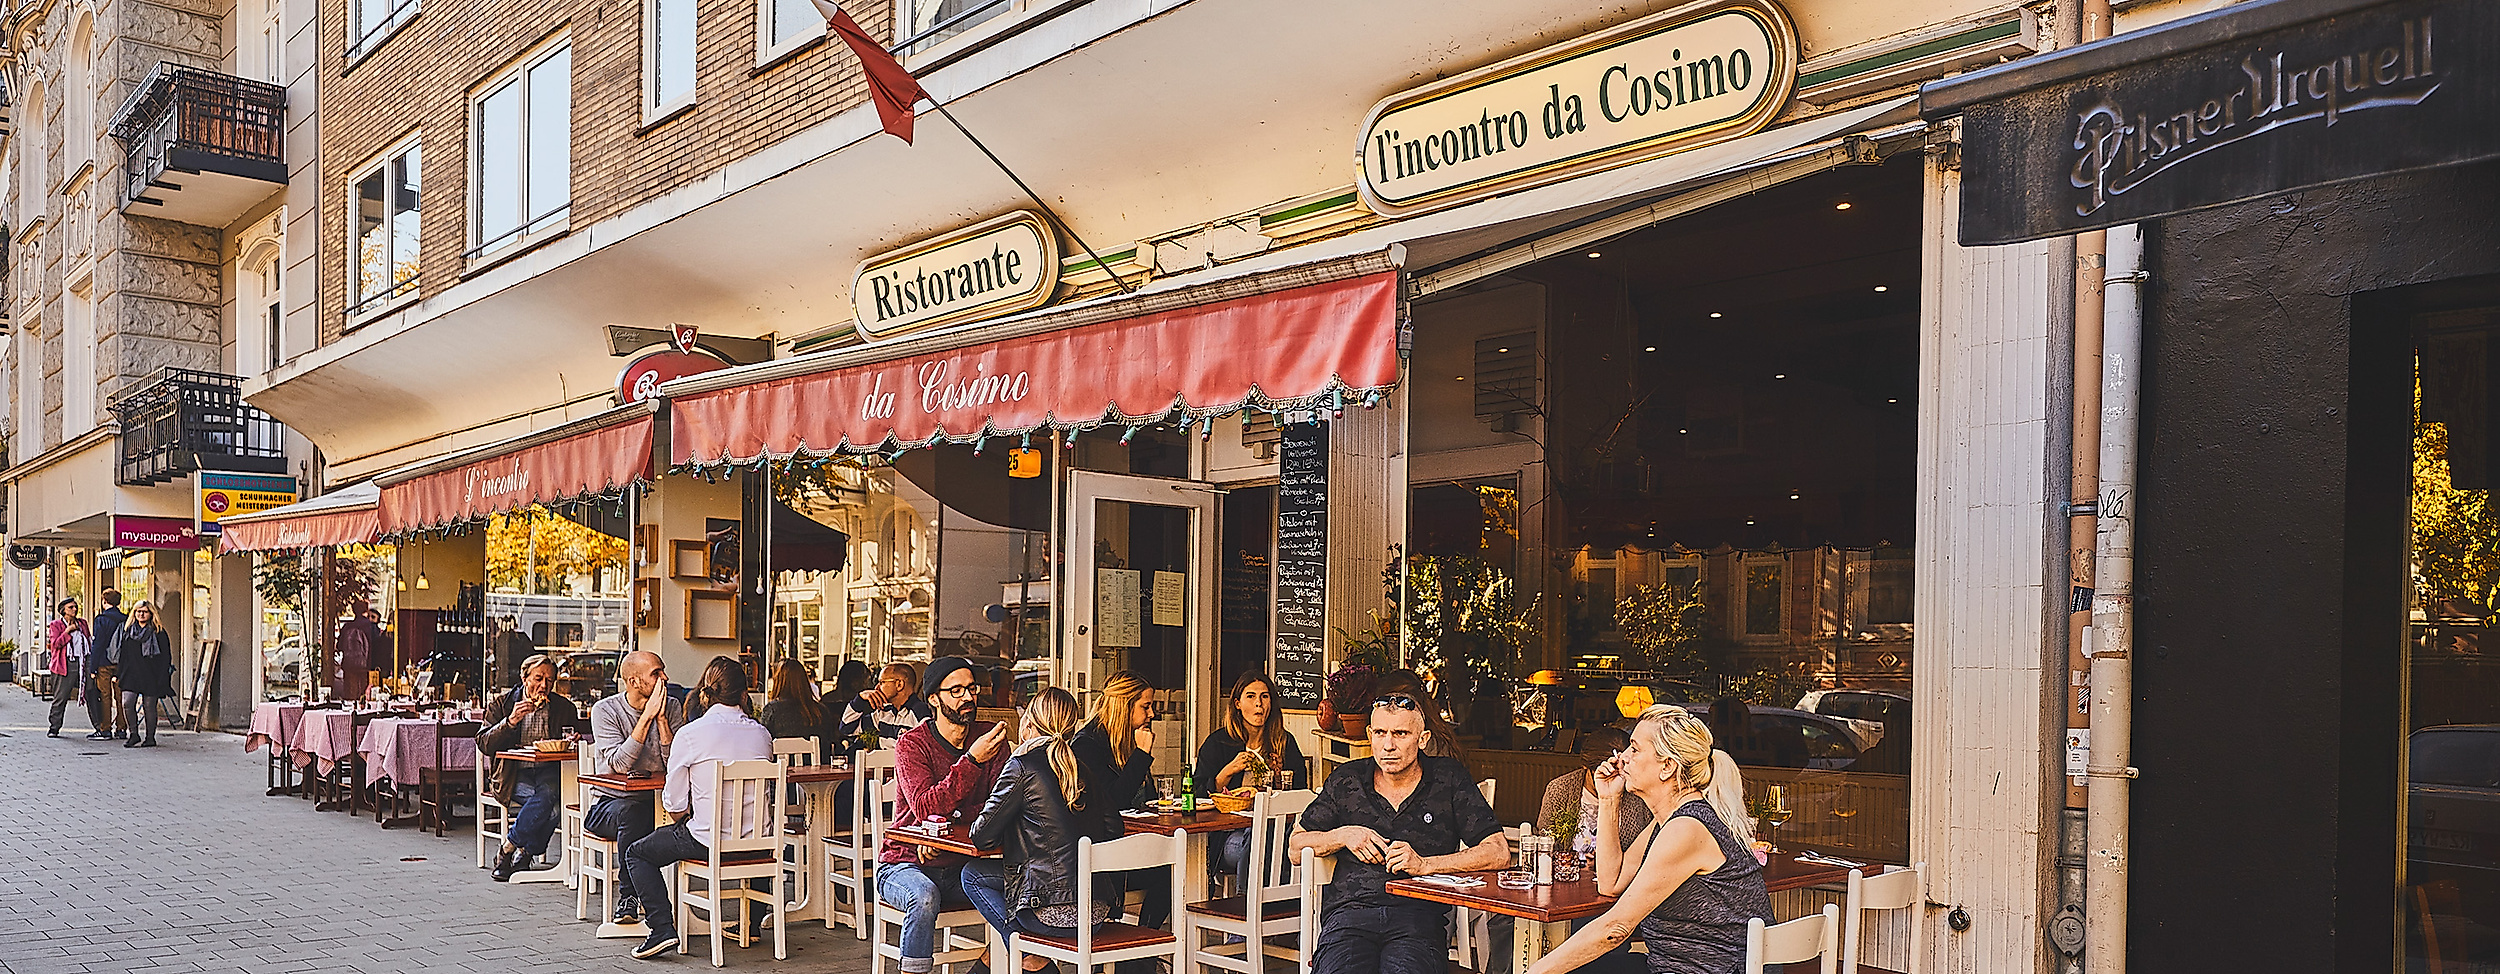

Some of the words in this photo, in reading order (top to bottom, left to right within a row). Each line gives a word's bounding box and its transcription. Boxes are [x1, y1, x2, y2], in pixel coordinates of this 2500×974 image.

[1375, 107, 1528, 184] l'incontro
[1542, 84, 1586, 140] da
[1599, 49, 1752, 124] Cosimo
[2069, 86, 2247, 217] Pilsner
[2241, 16, 2434, 127] Urquell
[870, 242, 1023, 323] Ristorante
[861, 372, 896, 421] da
[918, 359, 1030, 414] Cosimo
[205, 476, 292, 490] SCHLOSSNOTDIENST
[239, 493, 292, 502] SCHUHMACHER
[463, 457, 529, 503] L'incontro
[121, 531, 181, 544] mysupper
